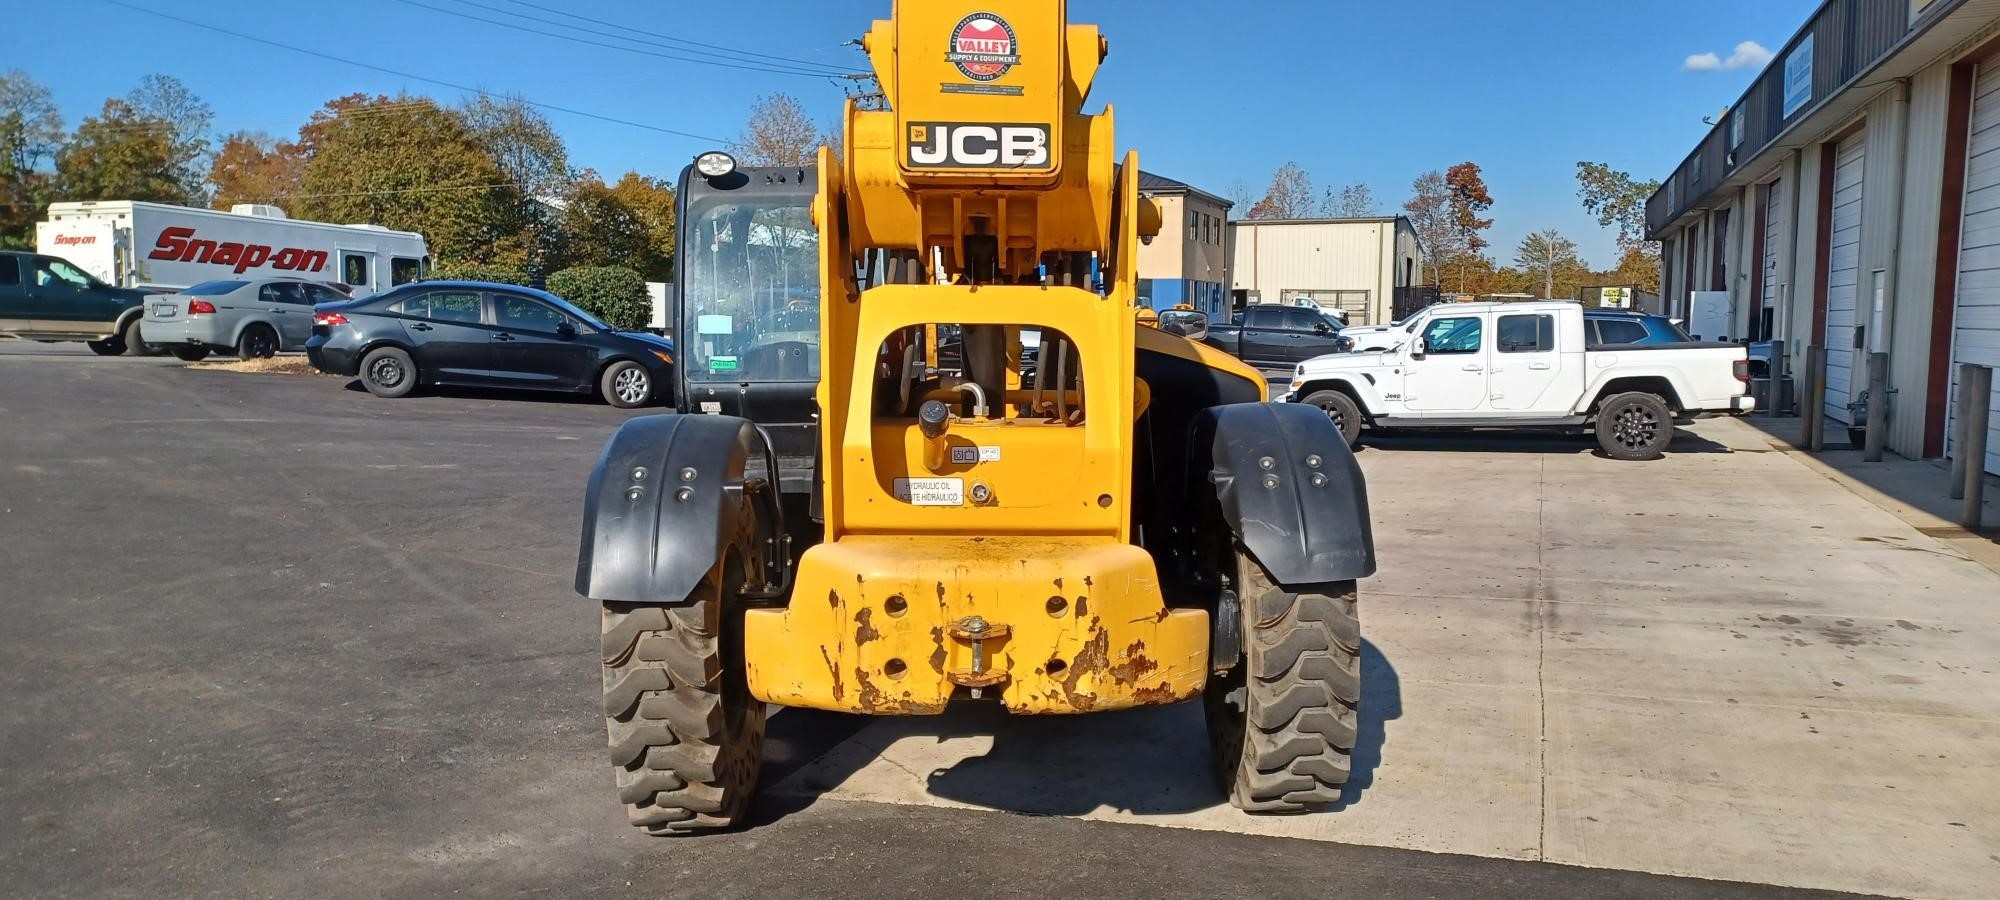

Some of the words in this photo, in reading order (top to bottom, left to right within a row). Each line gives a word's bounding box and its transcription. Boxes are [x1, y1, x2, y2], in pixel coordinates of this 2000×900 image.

[958, 40, 1009, 53] VALLEY
[980, 55, 1017, 63] EQUIPMENT
[958, 64, 994, 80] ESTABLISHED
[910, 126, 1047, 165] JCB
[53, 233, 96, 247] Snap-on
[148, 226, 328, 274] Snap-on
[1384, 392, 1401, 400] Jeep
[905, 482, 940, 490] HYDRAULIC
[940, 482, 951, 490] OIL
[900, 493, 921, 501] ACEITE
